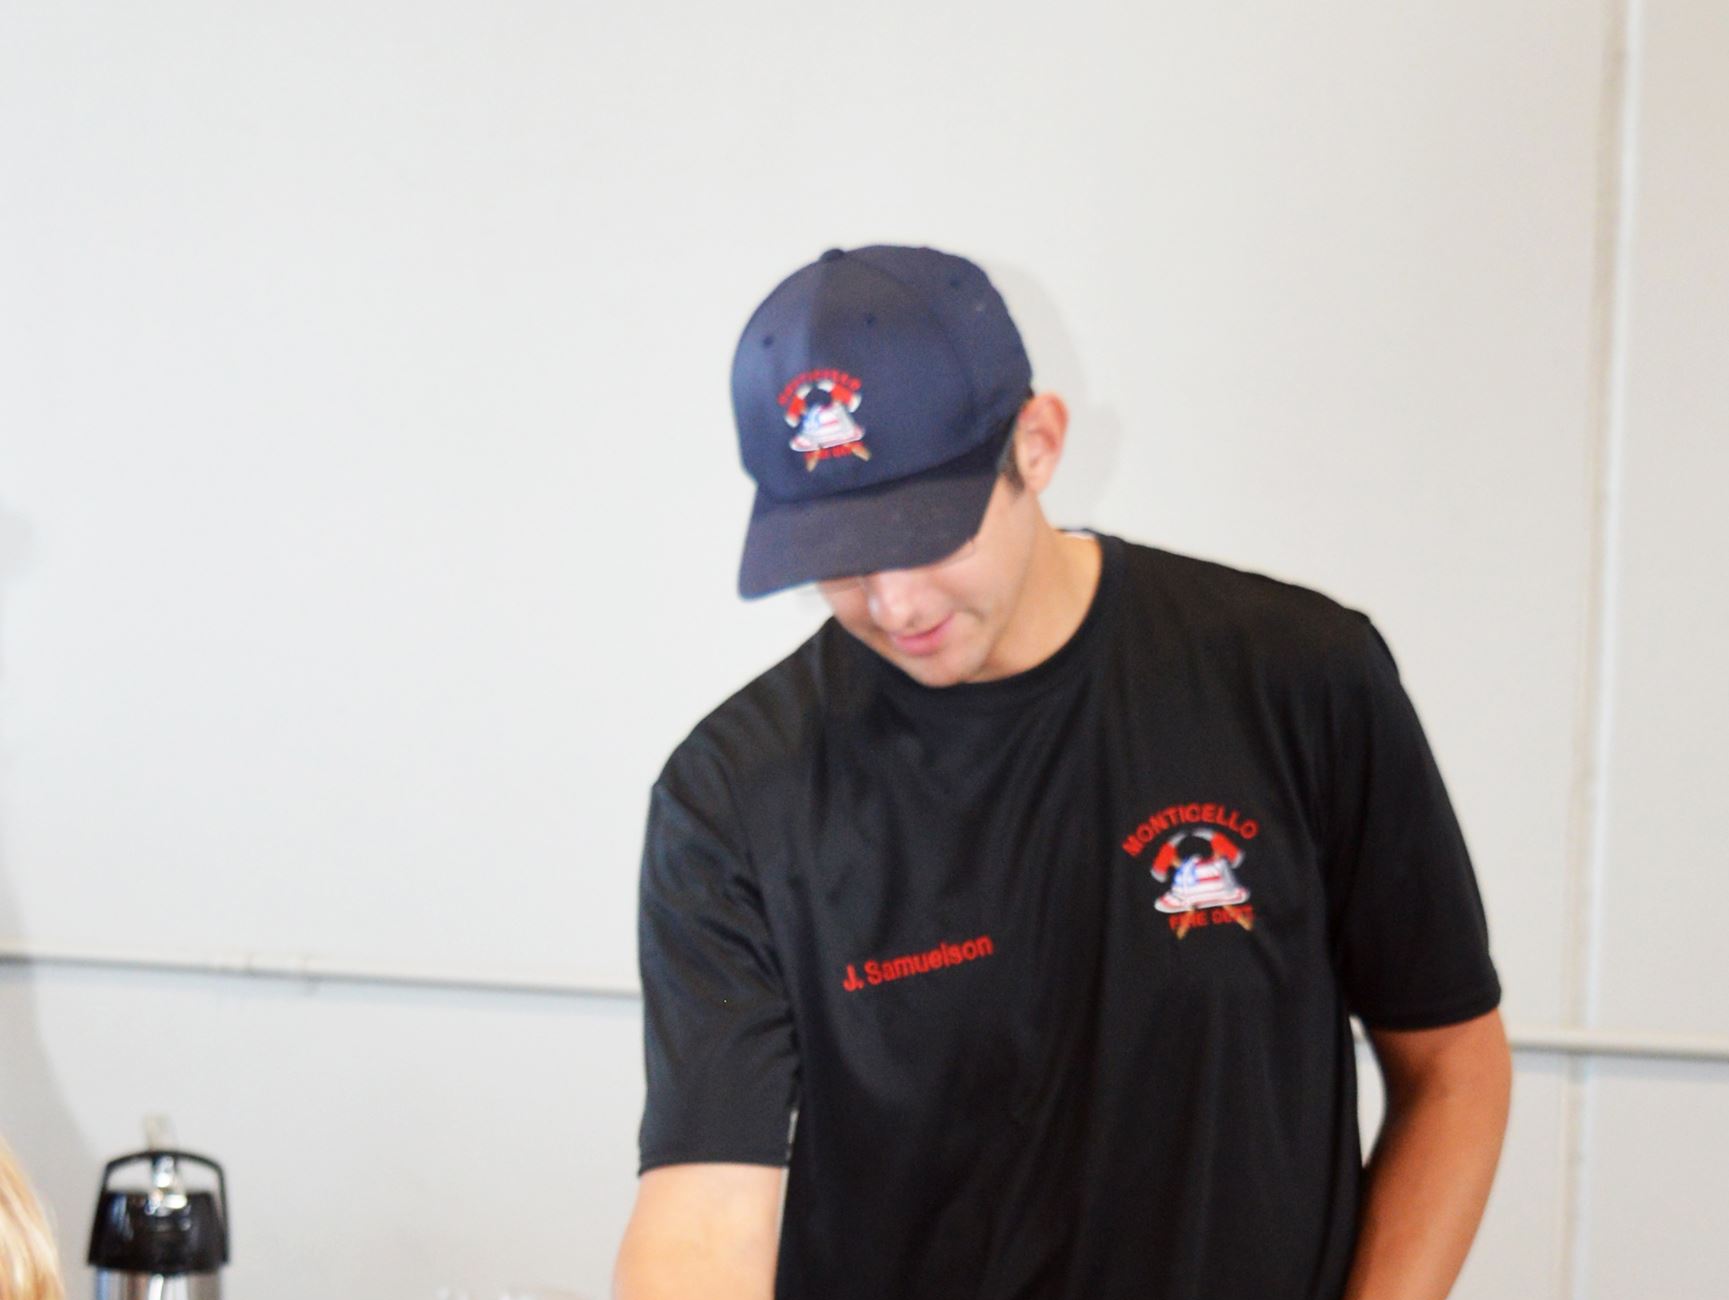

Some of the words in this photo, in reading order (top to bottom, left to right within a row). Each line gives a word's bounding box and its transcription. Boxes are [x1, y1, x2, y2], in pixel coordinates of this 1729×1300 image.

[1122, 803, 1259, 858] MONTICELLO
[843, 964, 865, 992] J.
[864, 935, 993, 985] Samuelson
